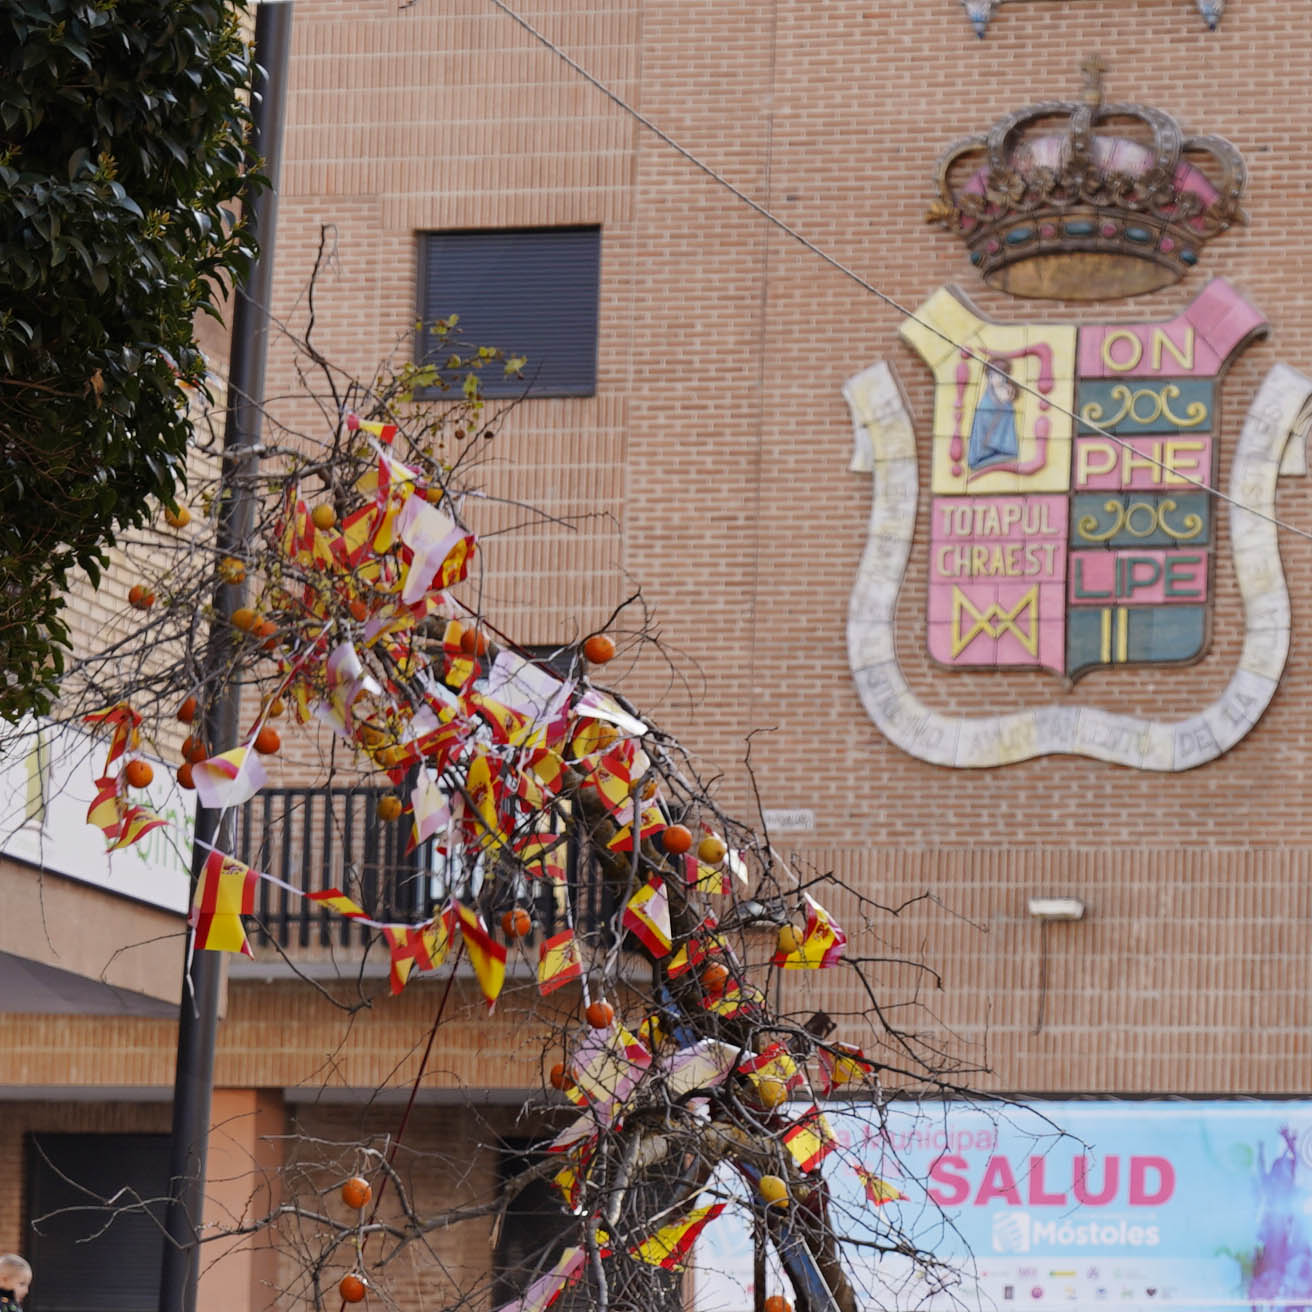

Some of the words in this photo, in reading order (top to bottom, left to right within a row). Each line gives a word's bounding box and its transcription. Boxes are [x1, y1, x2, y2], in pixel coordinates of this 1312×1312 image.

[1102, 327, 1194, 371] ON
[1077, 440, 1205, 484] PHE
[1074, 556, 1202, 599] LIPE
[1179, 727, 1215, 758] DE
[925, 1154, 1177, 1208] SALUD
[1032, 1219, 1161, 1247] Móstoles
